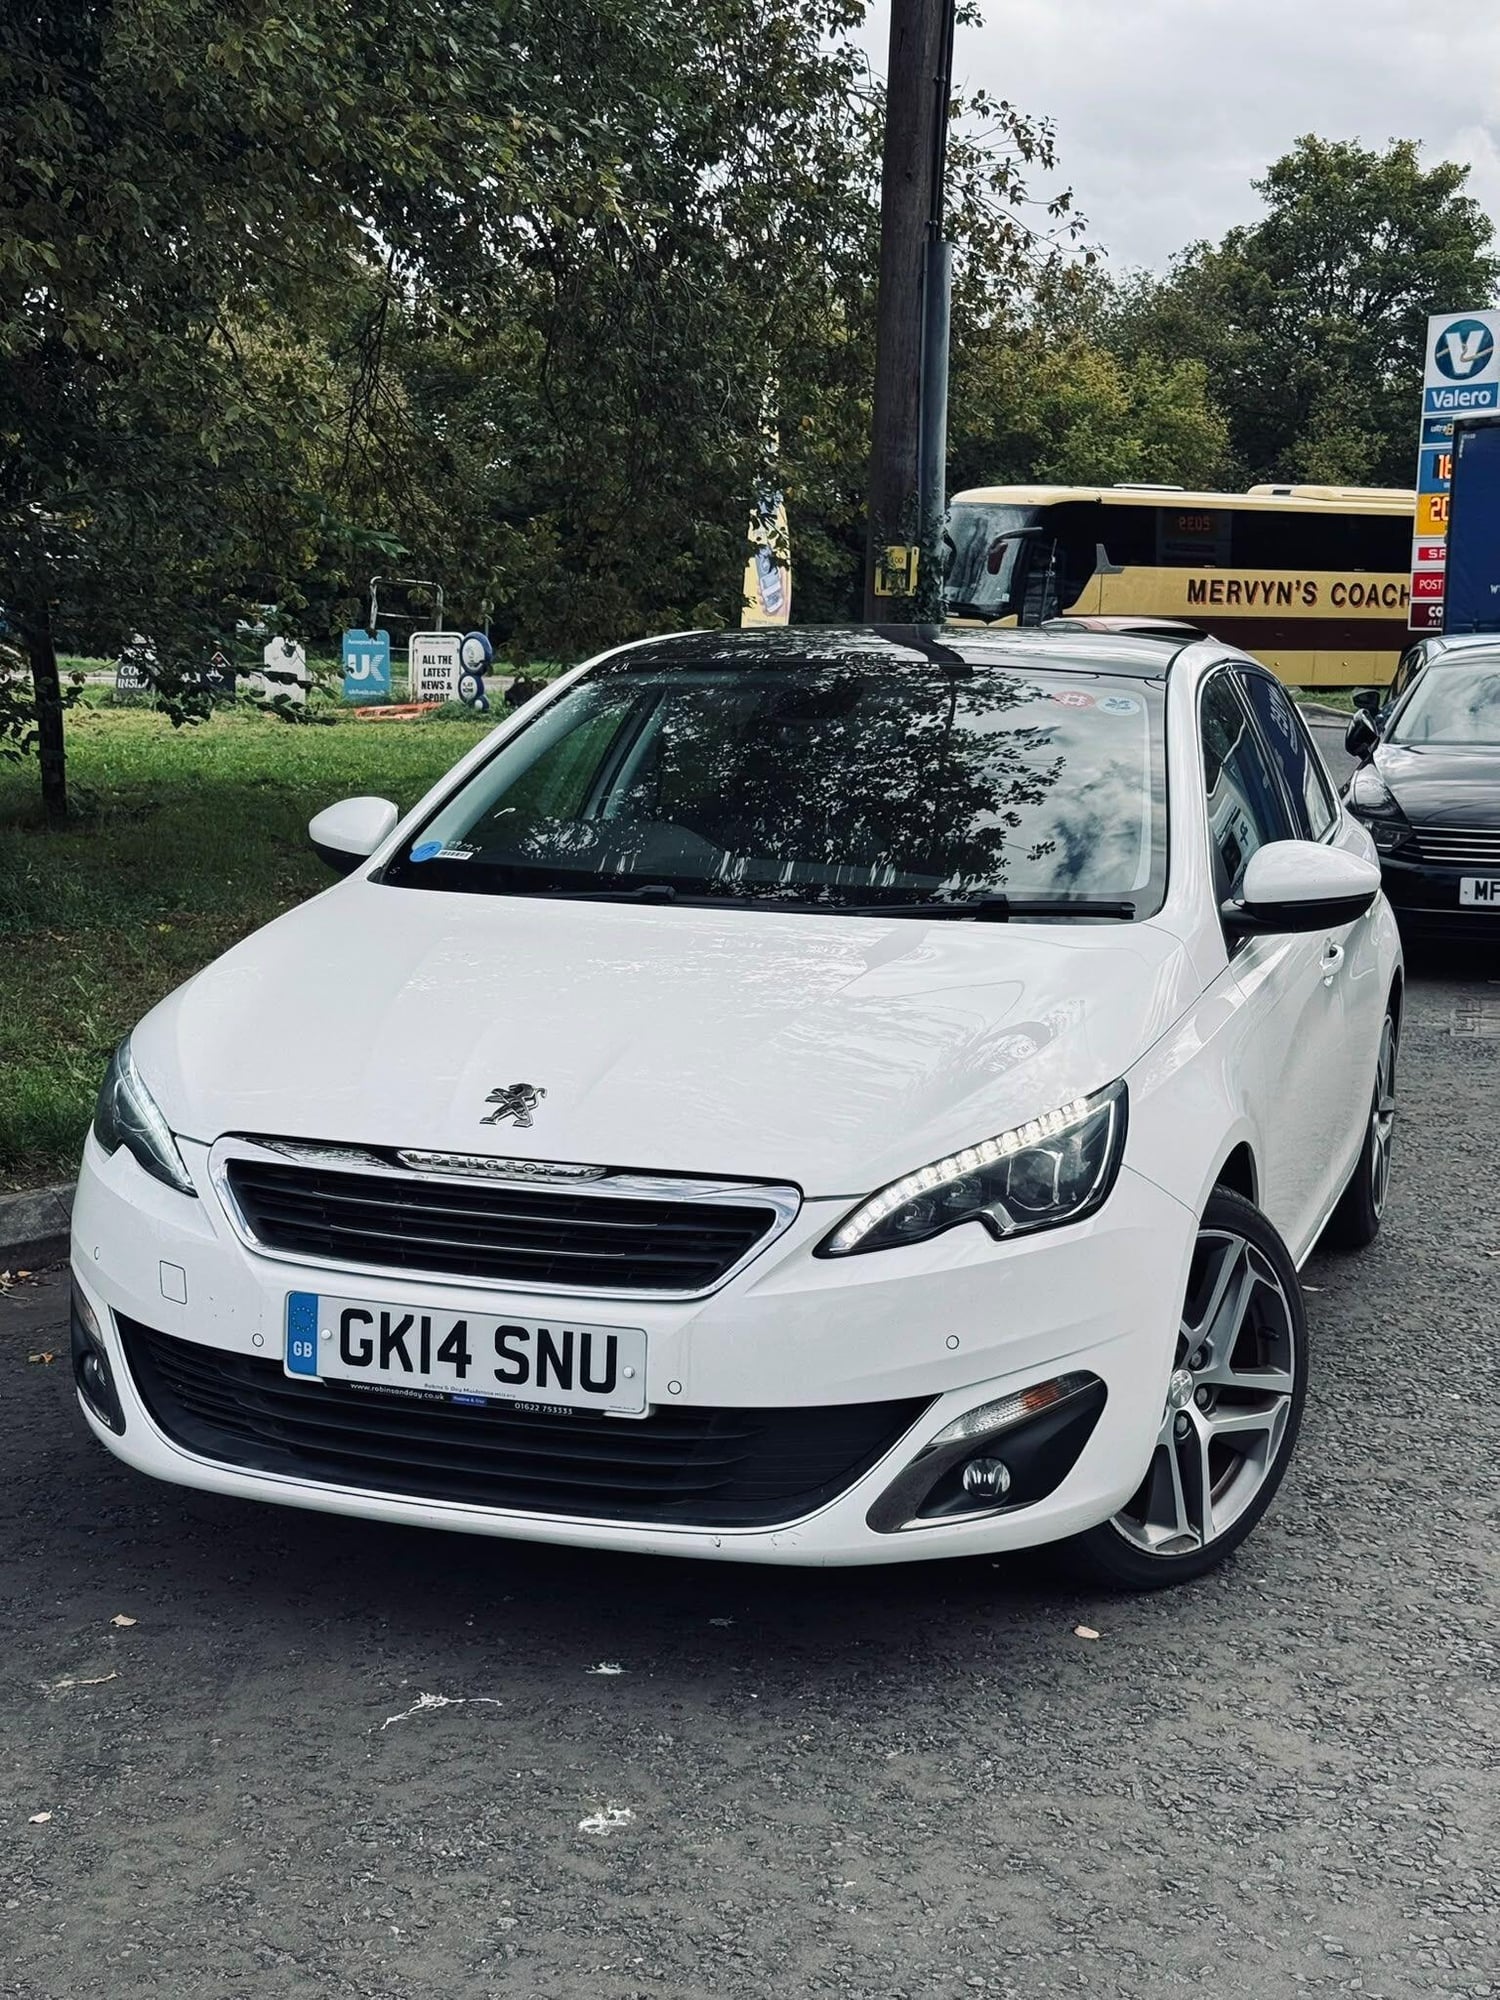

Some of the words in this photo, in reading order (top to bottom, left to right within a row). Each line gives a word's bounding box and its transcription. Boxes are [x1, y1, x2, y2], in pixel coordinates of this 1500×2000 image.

[1431, 389, 1491, 409] Valero
[1419, 579, 1443, 591] POST
[1187, 578, 1318, 607] MERVYN'S
[422, 655, 436, 665] ALL
[437, 655, 452, 665] THE
[423, 667, 451, 678] LATEST
[421, 681, 445, 690] NEWS
[446, 682, 453, 690] &
[423, 693, 450, 702] SPORT
[430, 1154, 555, 1176] PEUGEOT
[292, 1341, 313, 1358] GB
[339, 1307, 472, 1379] GK14
[493, 1324, 618, 1395] SNU
[350, 1383, 445, 1401] www.robinsandday.co.uk
[514, 1402, 540, 1412] 01622
